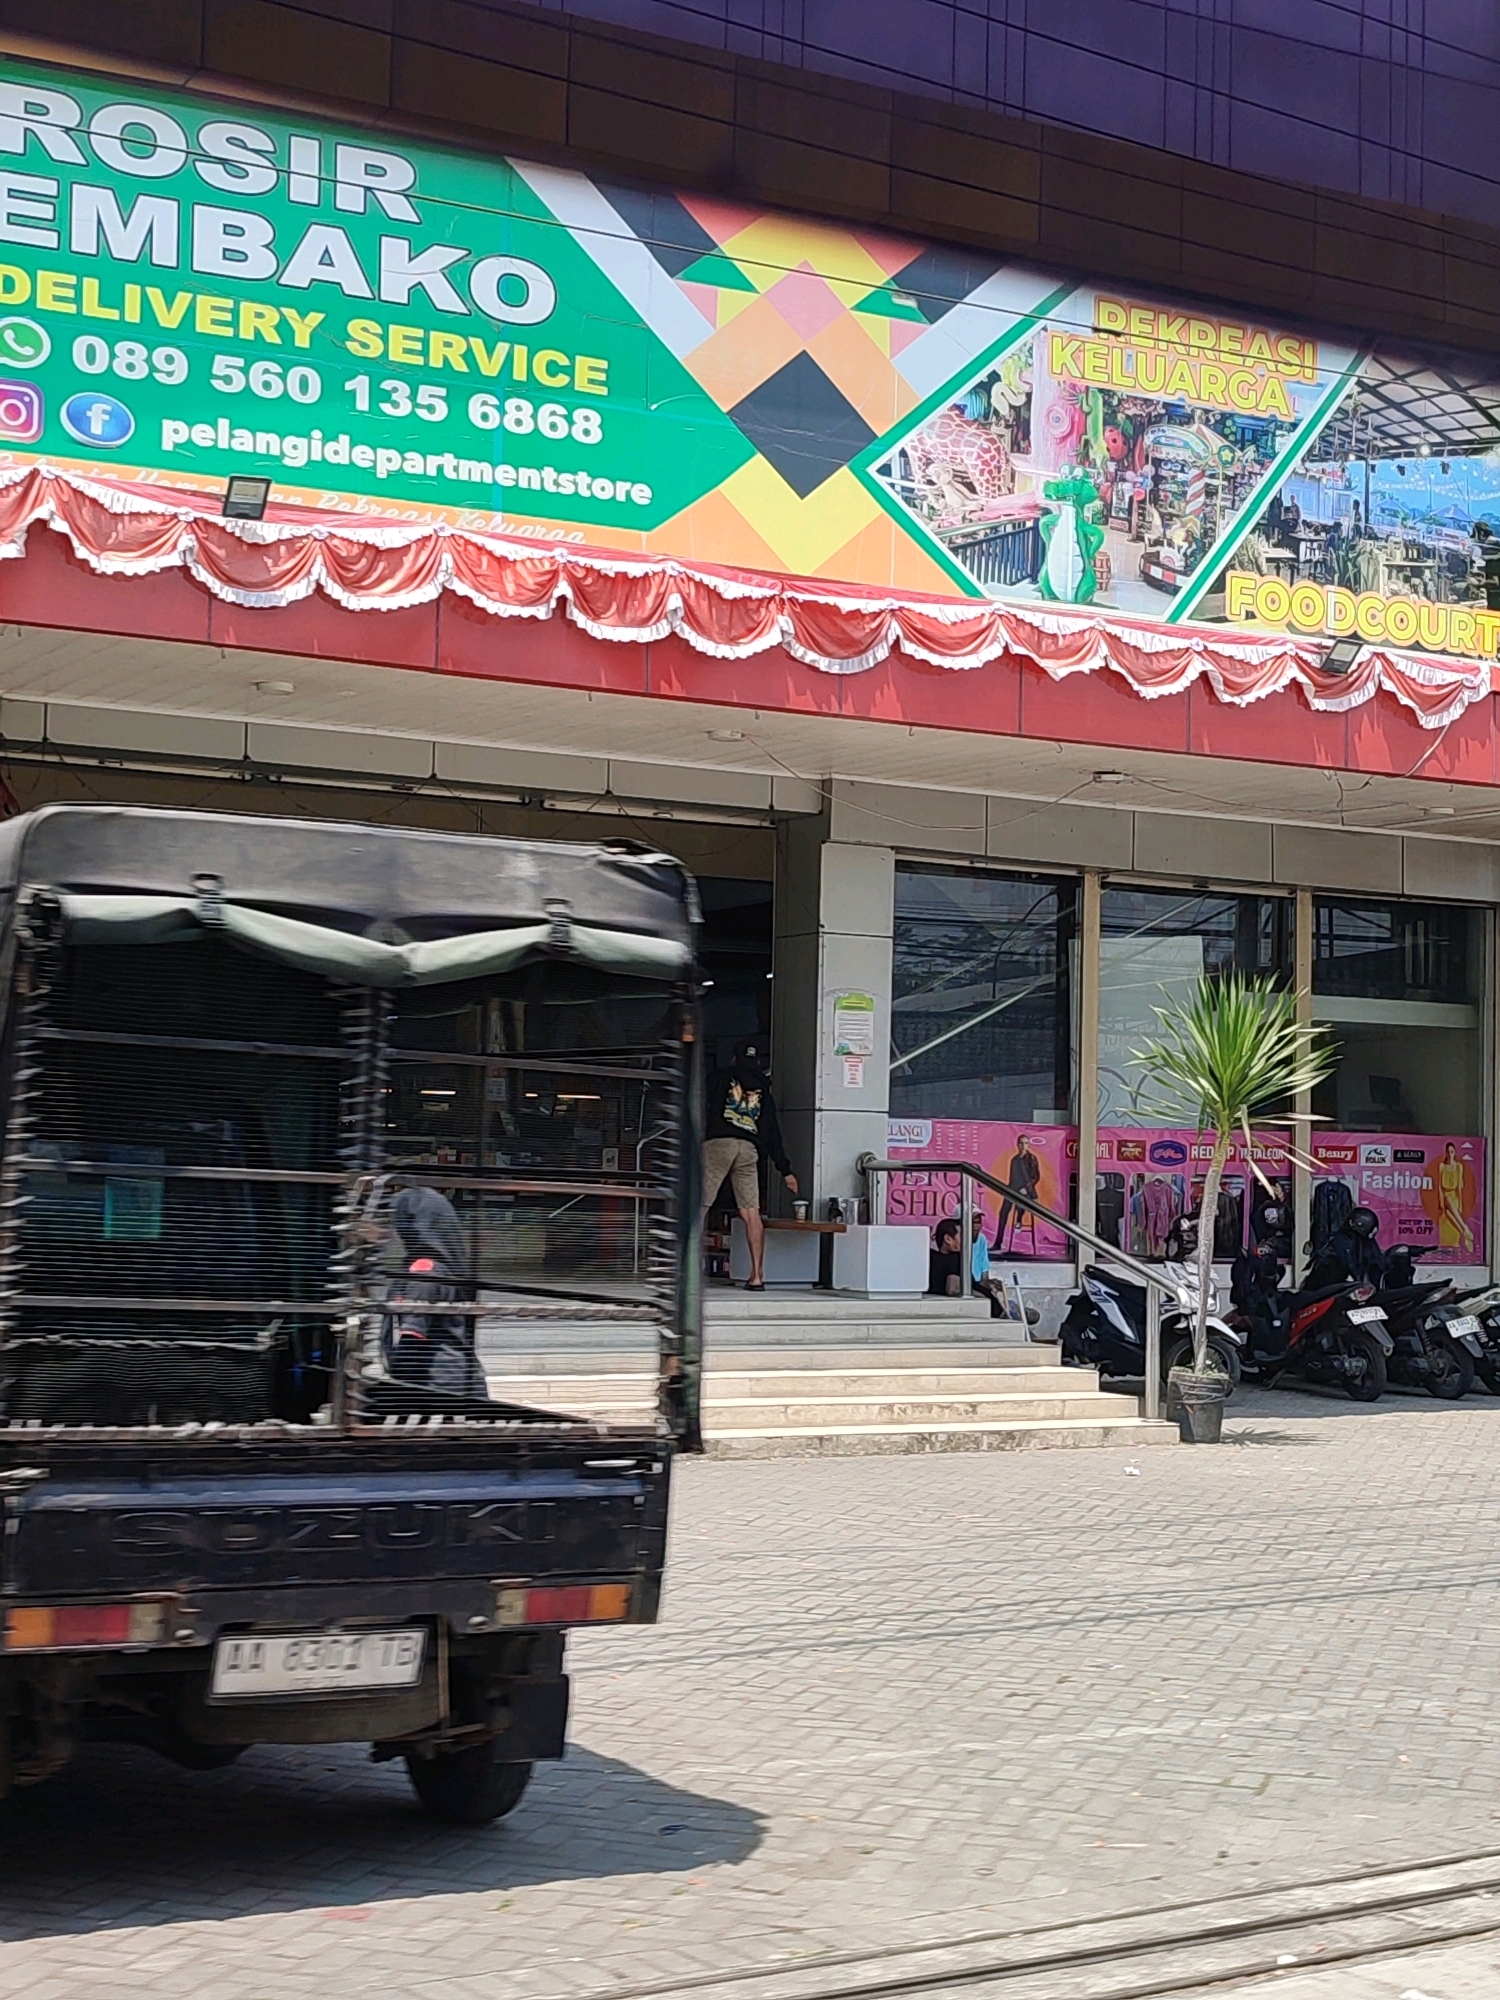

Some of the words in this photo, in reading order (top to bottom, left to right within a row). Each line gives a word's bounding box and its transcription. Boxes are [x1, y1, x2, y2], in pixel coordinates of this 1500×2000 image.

[0, 81, 421, 225] ROSIR
[0, 169, 557, 326] EMBAKO
[0, 264, 326, 348] DELIVERY
[345, 319, 608, 395] SERVICE
[1097, 299, 1315, 379] REKREASI
[72, 335, 188, 385] 089
[210, 354, 322, 404] 560
[345, 375, 448, 421] 135
[468, 393, 602, 444] 6868
[1051, 335, 1290, 416] KELUARGA
[161, 418, 652, 505] pelangidepartmentstore
[1230, 576, 1500, 652] FOODCOURT
[888, 1124, 923, 1137] LANGI
[1362, 1170, 1433, 1190] Fashion
[111, 1501, 557, 1556] SUZUKI
